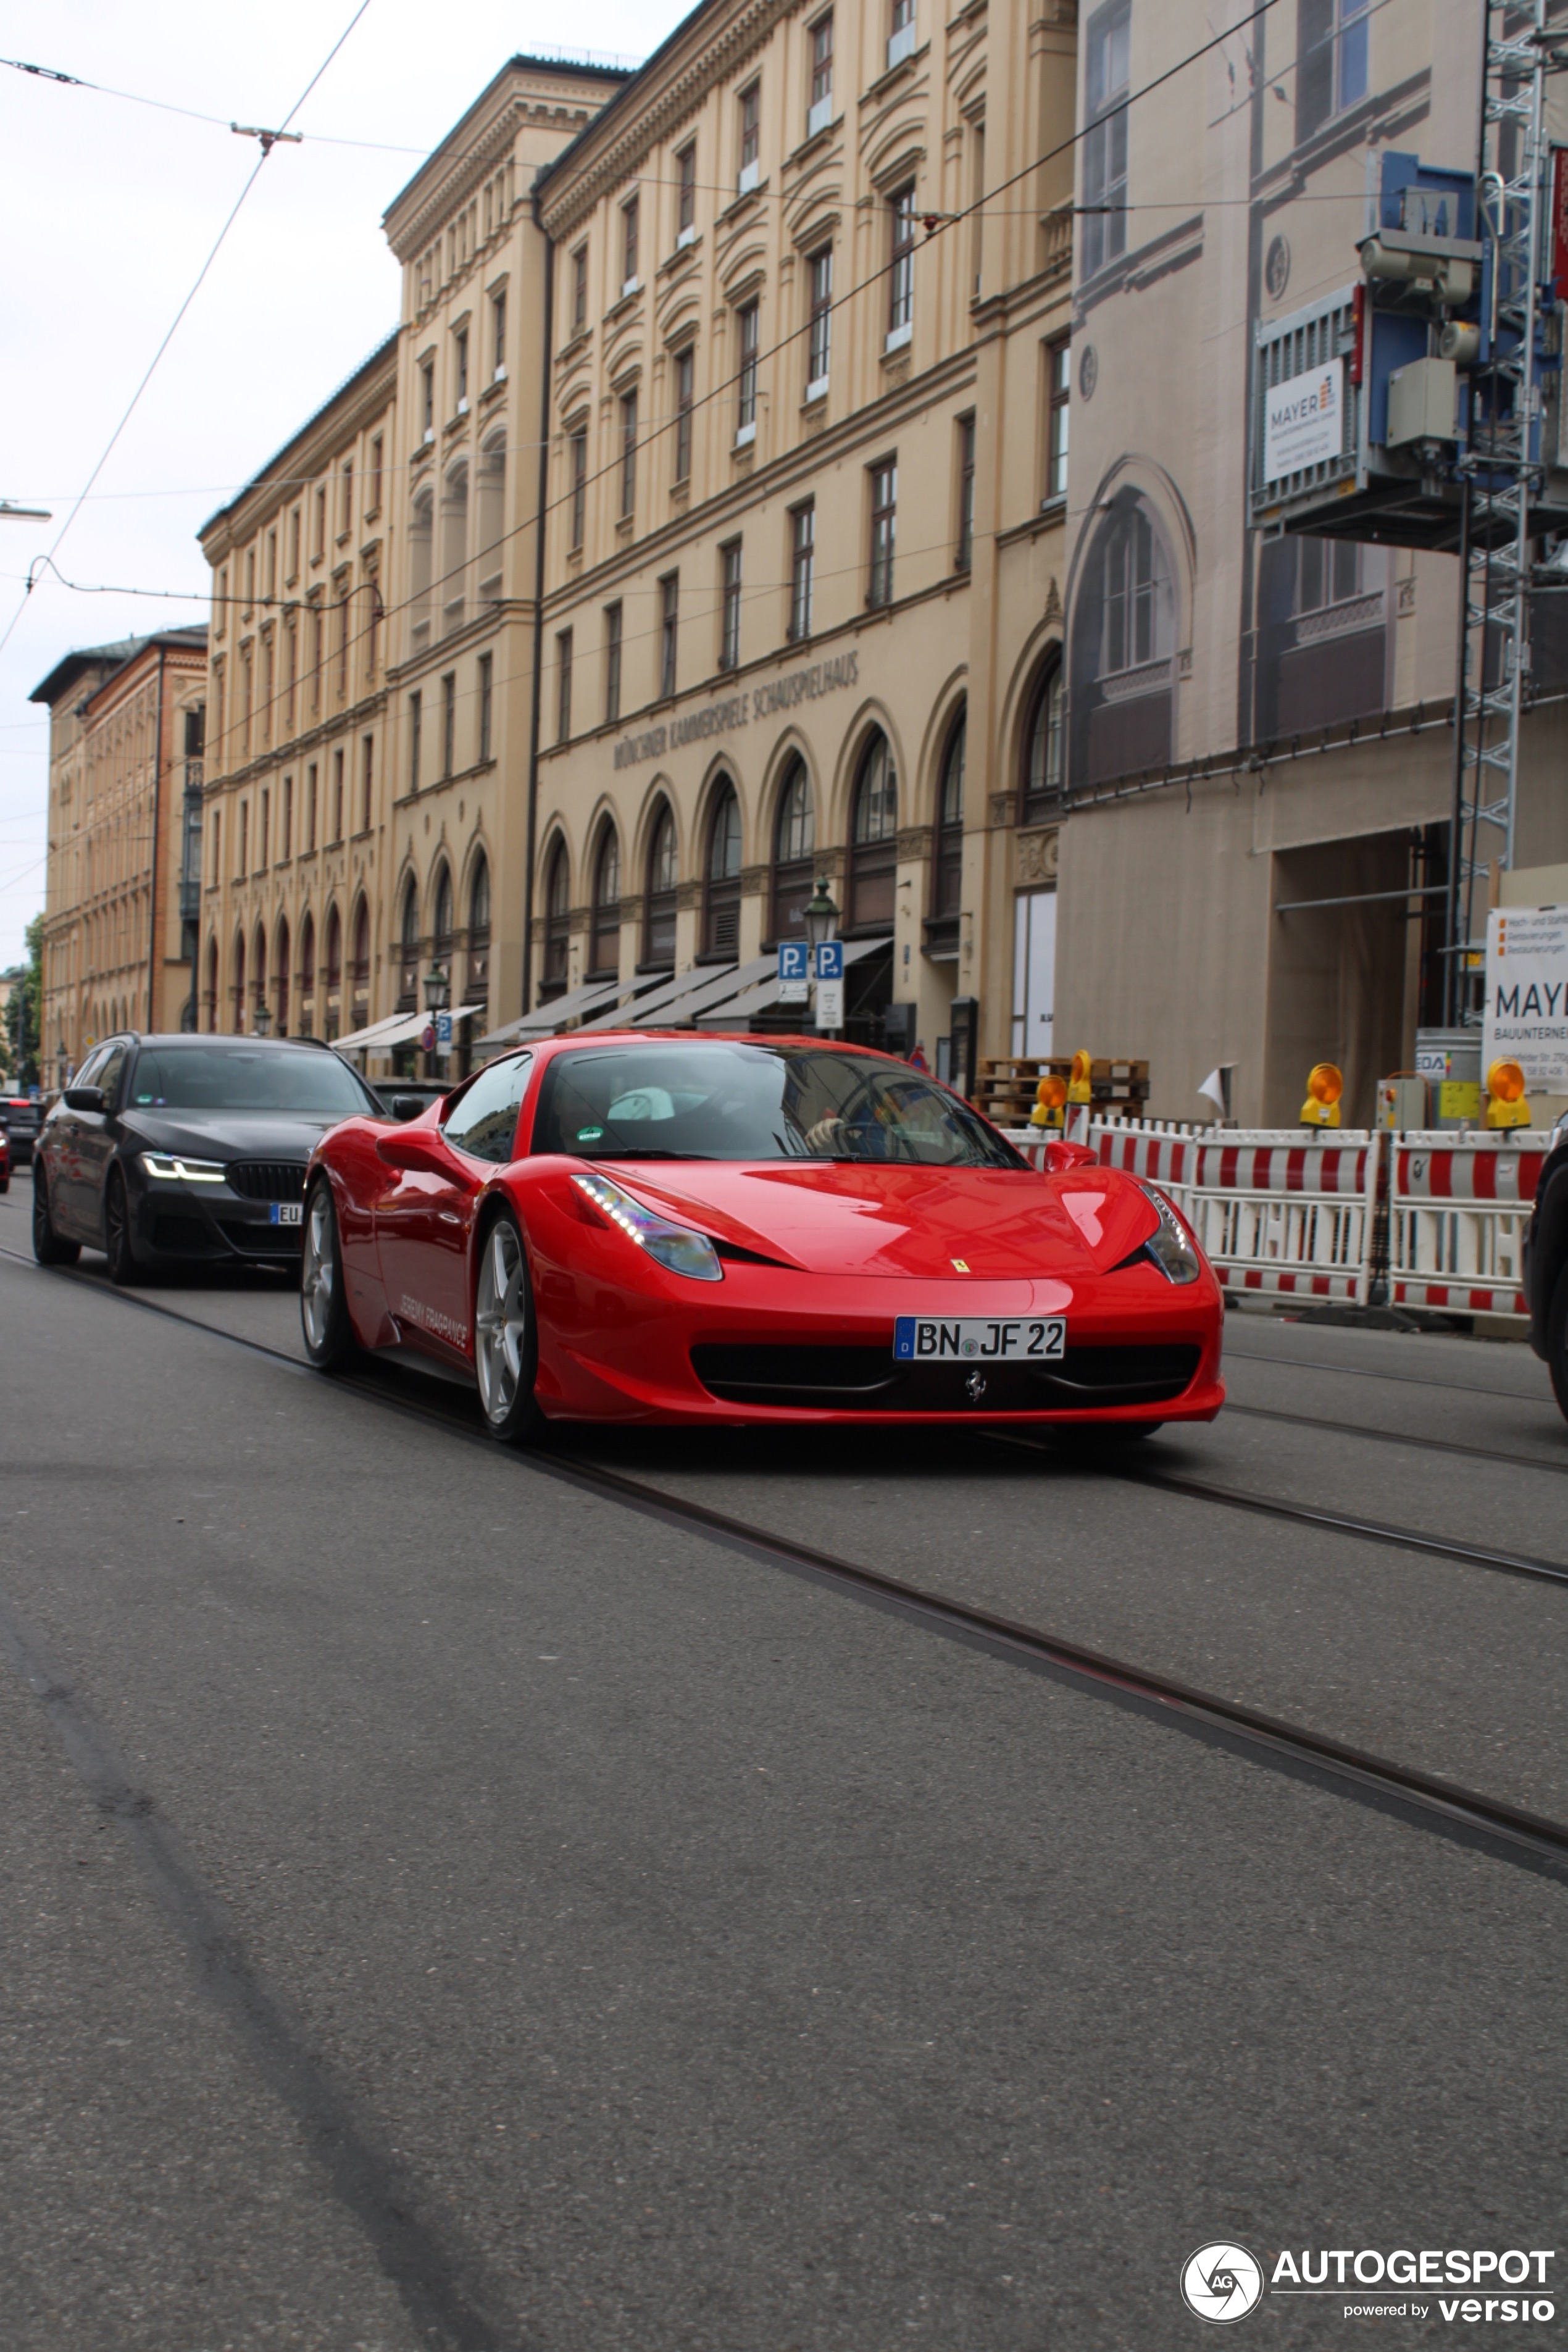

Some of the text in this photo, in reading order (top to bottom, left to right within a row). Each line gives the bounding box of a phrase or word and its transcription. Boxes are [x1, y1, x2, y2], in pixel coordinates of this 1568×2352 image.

[1271, 394, 1318, 430] MAYER
[614, 649, 859, 770] MÜNCHNER KAMMERSPIELE SCHAUSPIELHAUS
[782, 948, 799, 977] P
[820, 946, 835, 975] P
[1496, 982, 1568, 1018] MAY
[1495, 1027, 1568, 1040] BAUUNTERNE
[280, 1206, 298, 1222] EU
[400, 1294, 467, 1348] JEREMY FRAGRANCE
[901, 1324, 1062, 1355] D BN JF 22
